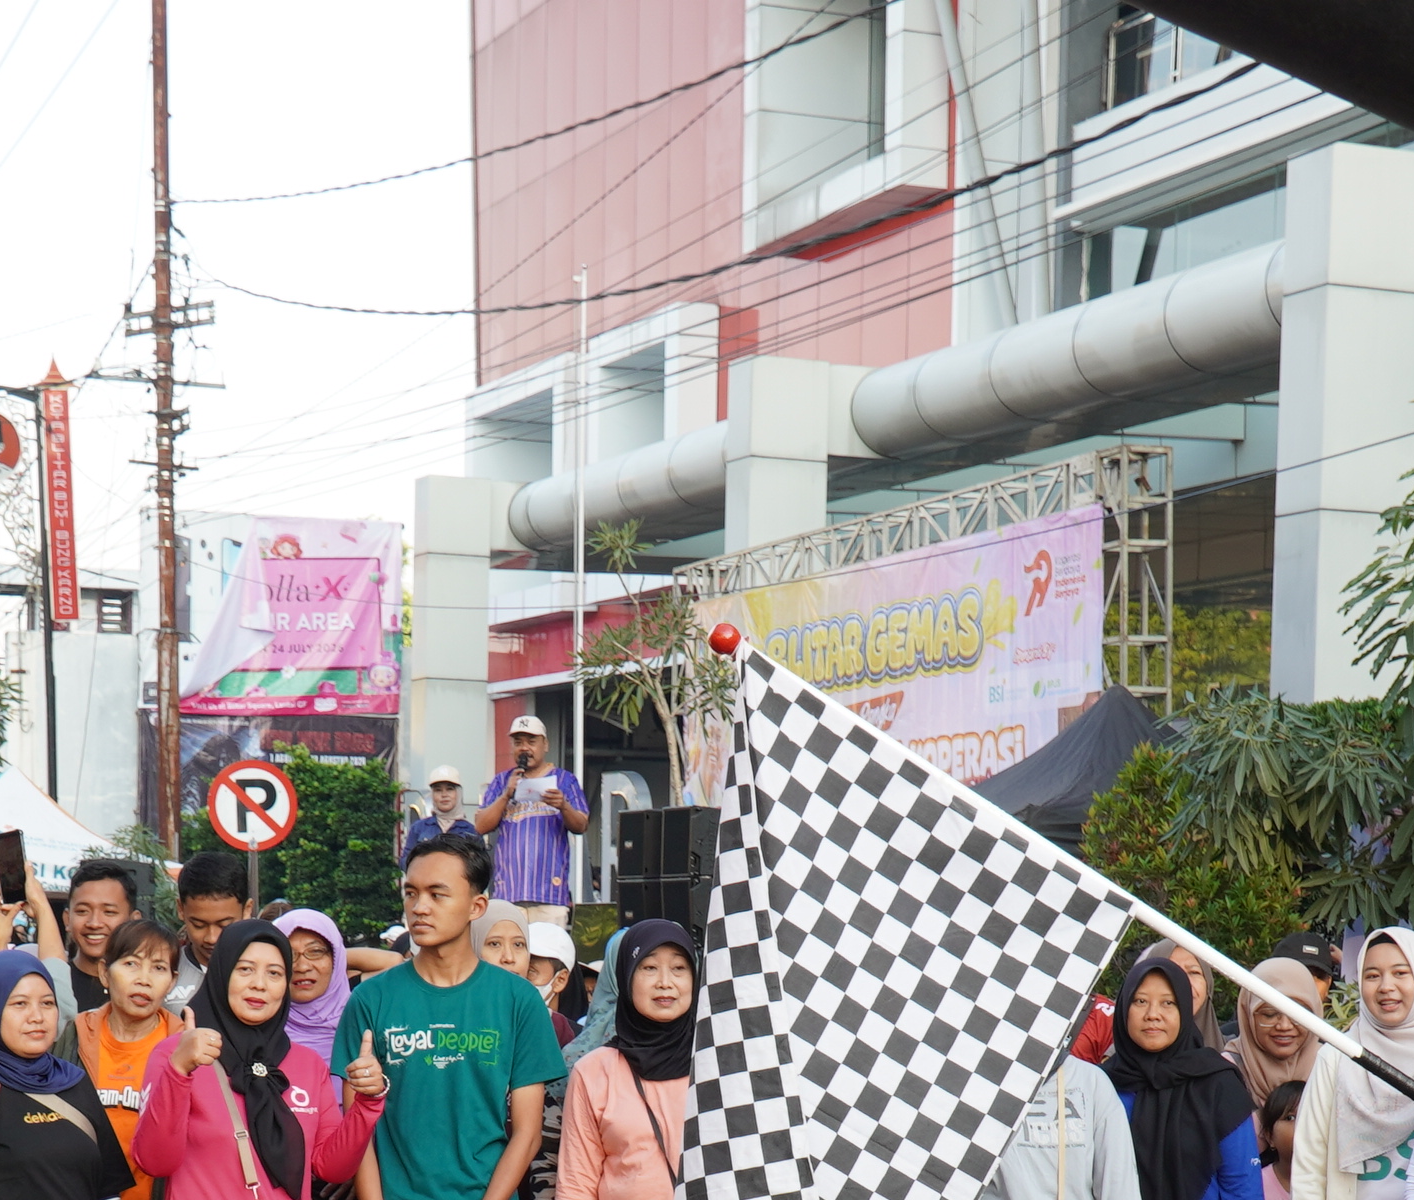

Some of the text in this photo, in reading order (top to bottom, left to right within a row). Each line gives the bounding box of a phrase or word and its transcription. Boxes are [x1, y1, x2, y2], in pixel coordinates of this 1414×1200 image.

[53, 490, 68, 527] BUMI
[55, 529, 70, 567] BUNG
[57, 570, 73, 616] KARNO
[296, 612, 356, 631] AREA
[766, 592, 982, 685] BLITAR GEMAS
[287, 643, 311, 653] JULY
[236, 779, 277, 832] P
